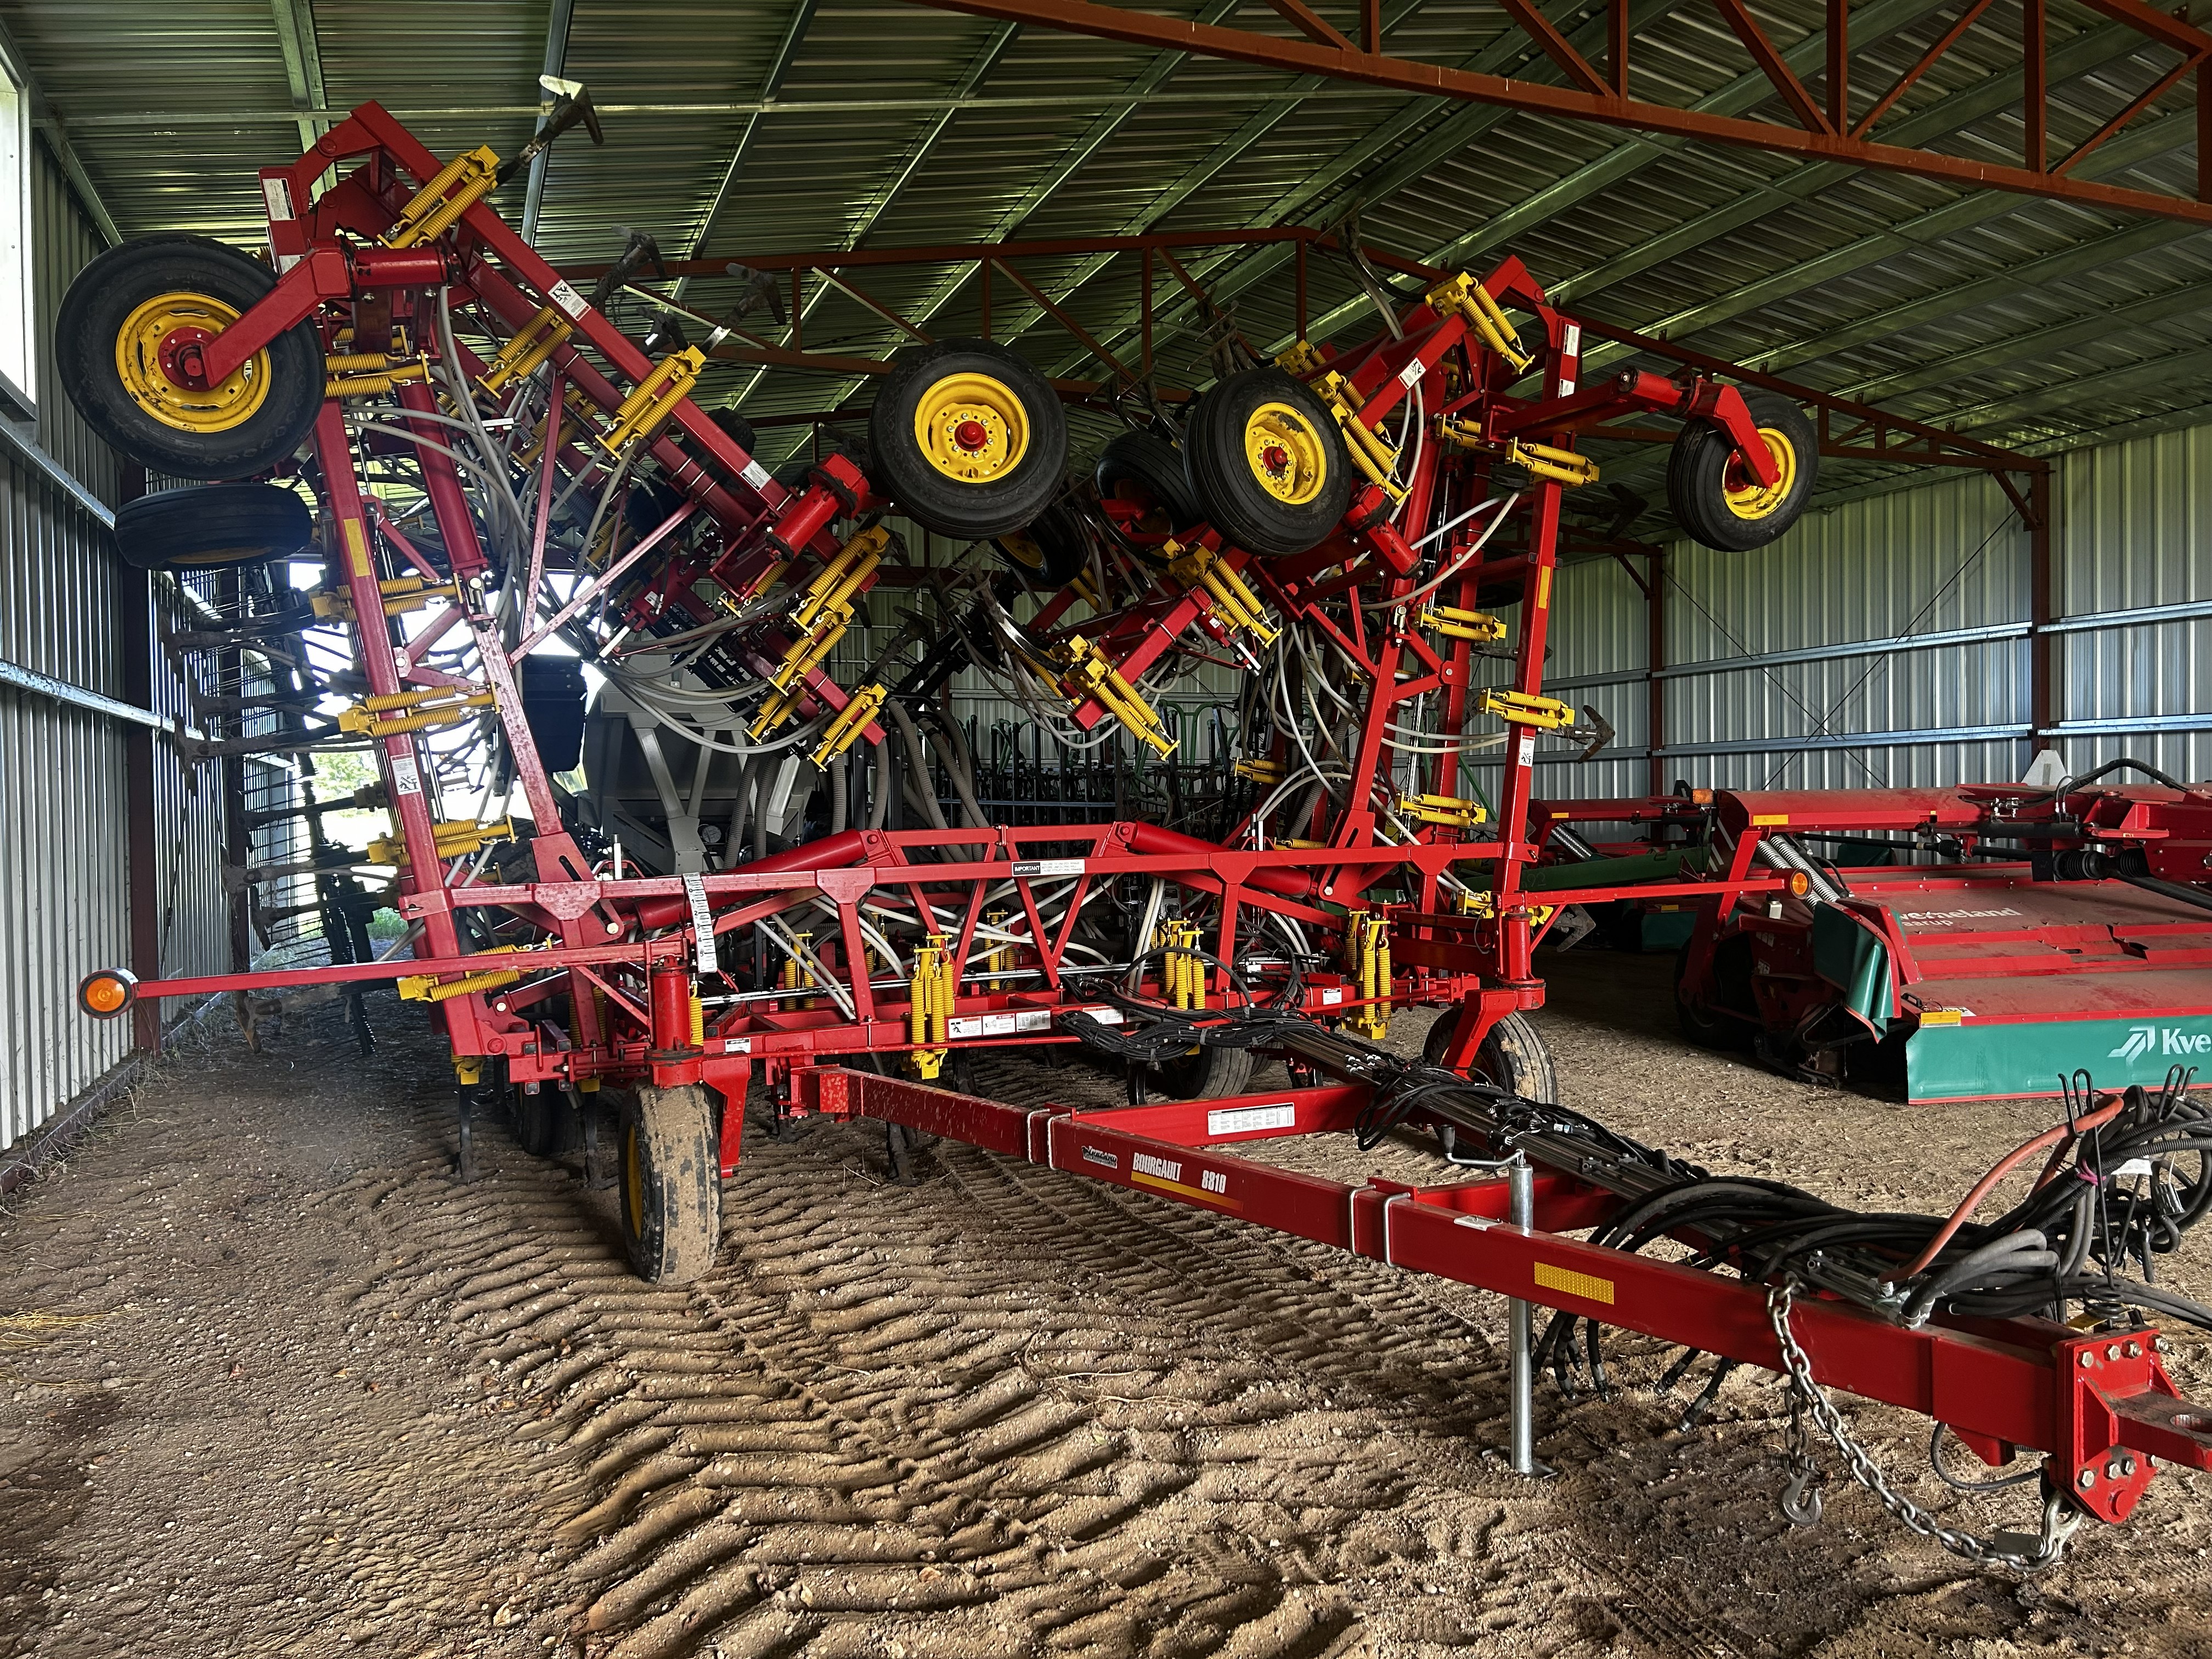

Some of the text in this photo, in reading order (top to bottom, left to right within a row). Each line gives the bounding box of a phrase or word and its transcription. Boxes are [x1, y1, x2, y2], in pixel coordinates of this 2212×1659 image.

[1899, 907, 2024, 920] verneland
[2162, 1028, 2212, 1055] Kve
[1133, 1153, 1182, 1182] BOURGAULT
[1201, 1170, 1227, 1193] 8810
